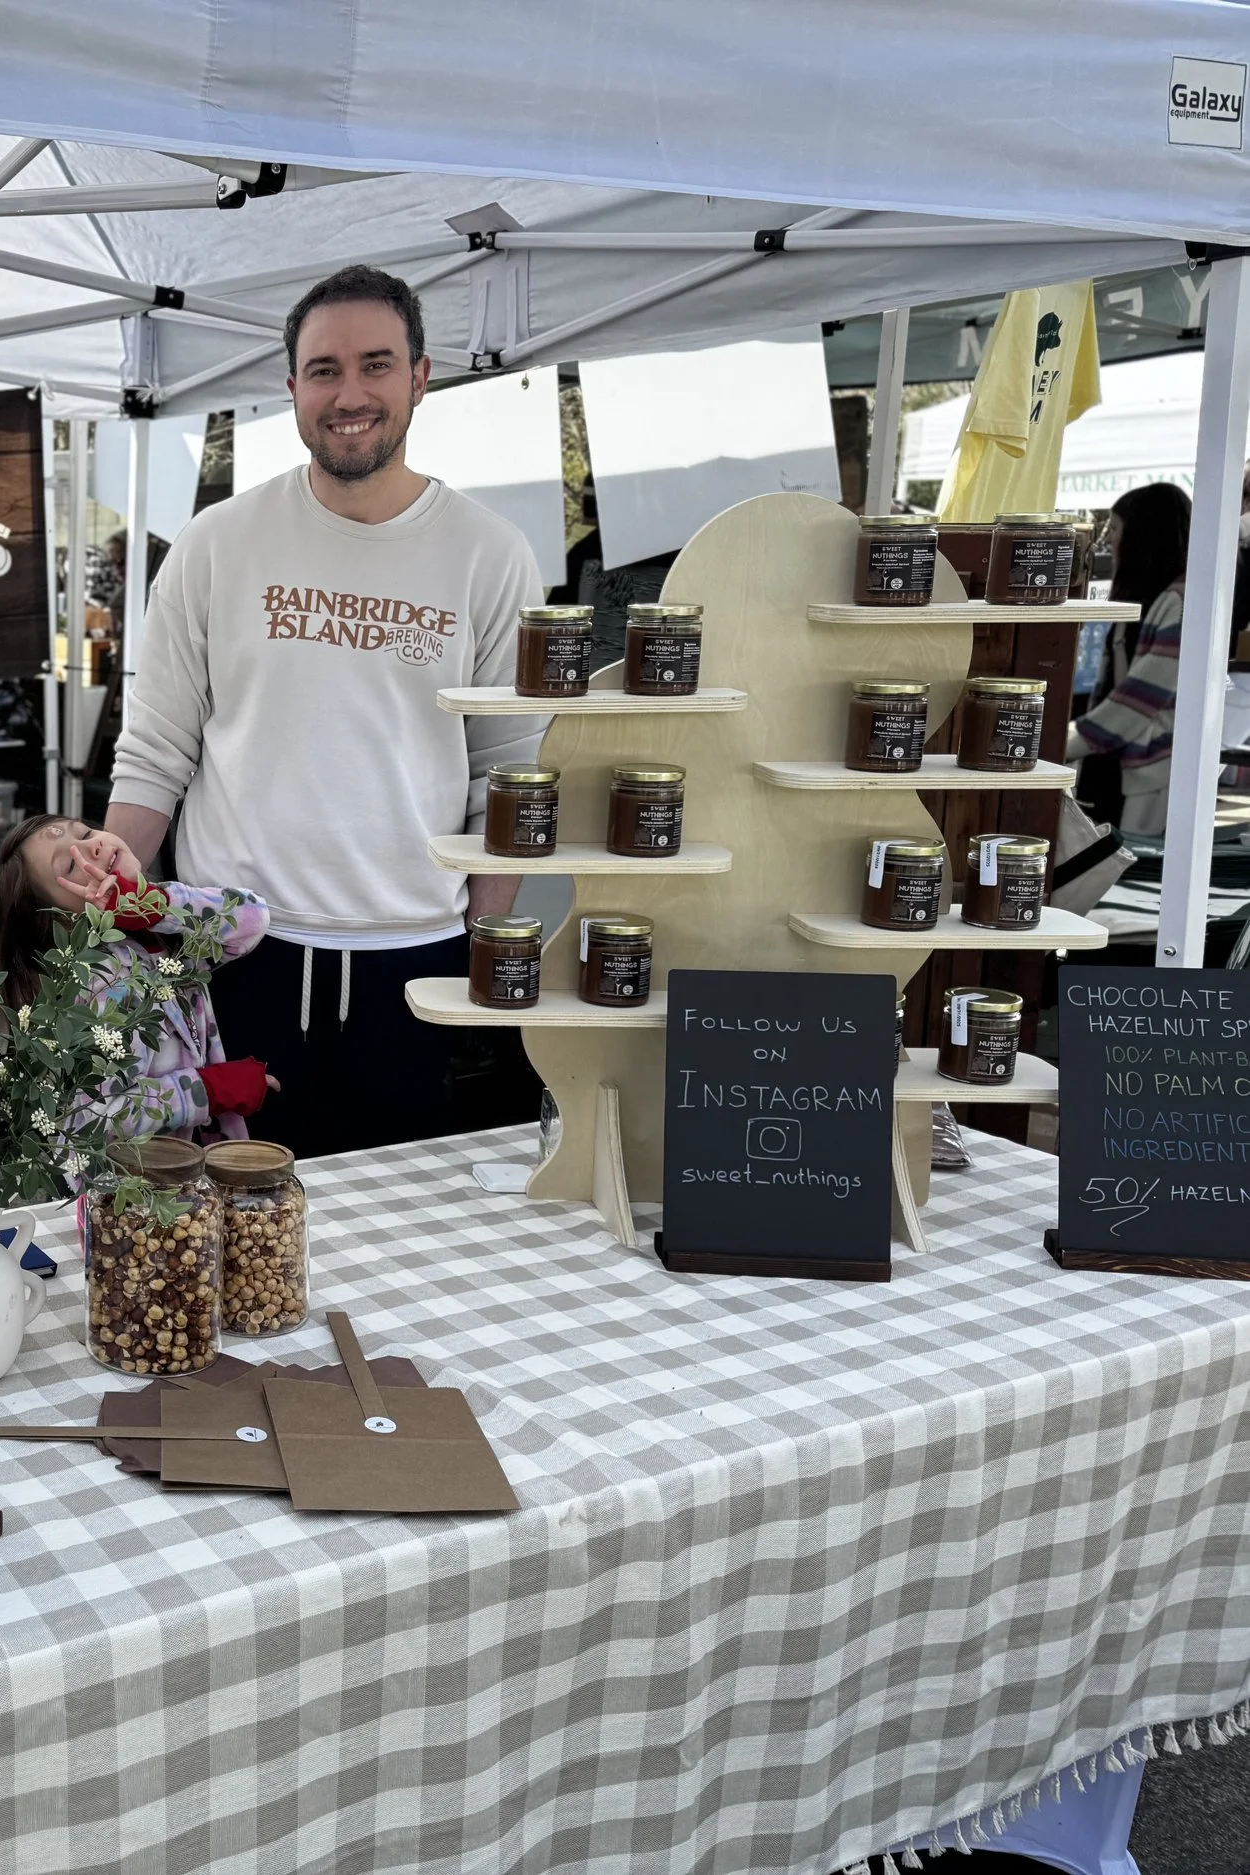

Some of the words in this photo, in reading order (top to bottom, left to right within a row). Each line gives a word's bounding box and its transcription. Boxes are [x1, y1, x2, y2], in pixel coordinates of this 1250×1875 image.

[1170, 108, 1210, 120] equipment
[1171, 83, 1242, 122] Galaxy
[262, 584, 458, 637] BAINBRIDGE
[267, 612, 387, 650] ISLAND
[385, 629, 444, 658] BREWING
[402, 645, 429, 661] CO.
[1067, 985, 1234, 1010] CHOCOLATE
[1089, 1015, 1211, 1037] HAZELNUT
[1221, 1019, 1250, 1038] SP
[1105, 1046, 1152, 1065] 100%
[1163, 1047, 1250, 1067] PLANT-B
[1105, 1071, 1143, 1096] NO
[1155, 1073, 1225, 1096] PALM
[1103, 1106, 1145, 1131] NO
[1103, 1137, 1250, 1162] INGREDIENT
[681, 1163, 862, 1199] sweet_nuthings
[1078, 1176, 1161, 1205] 50%
